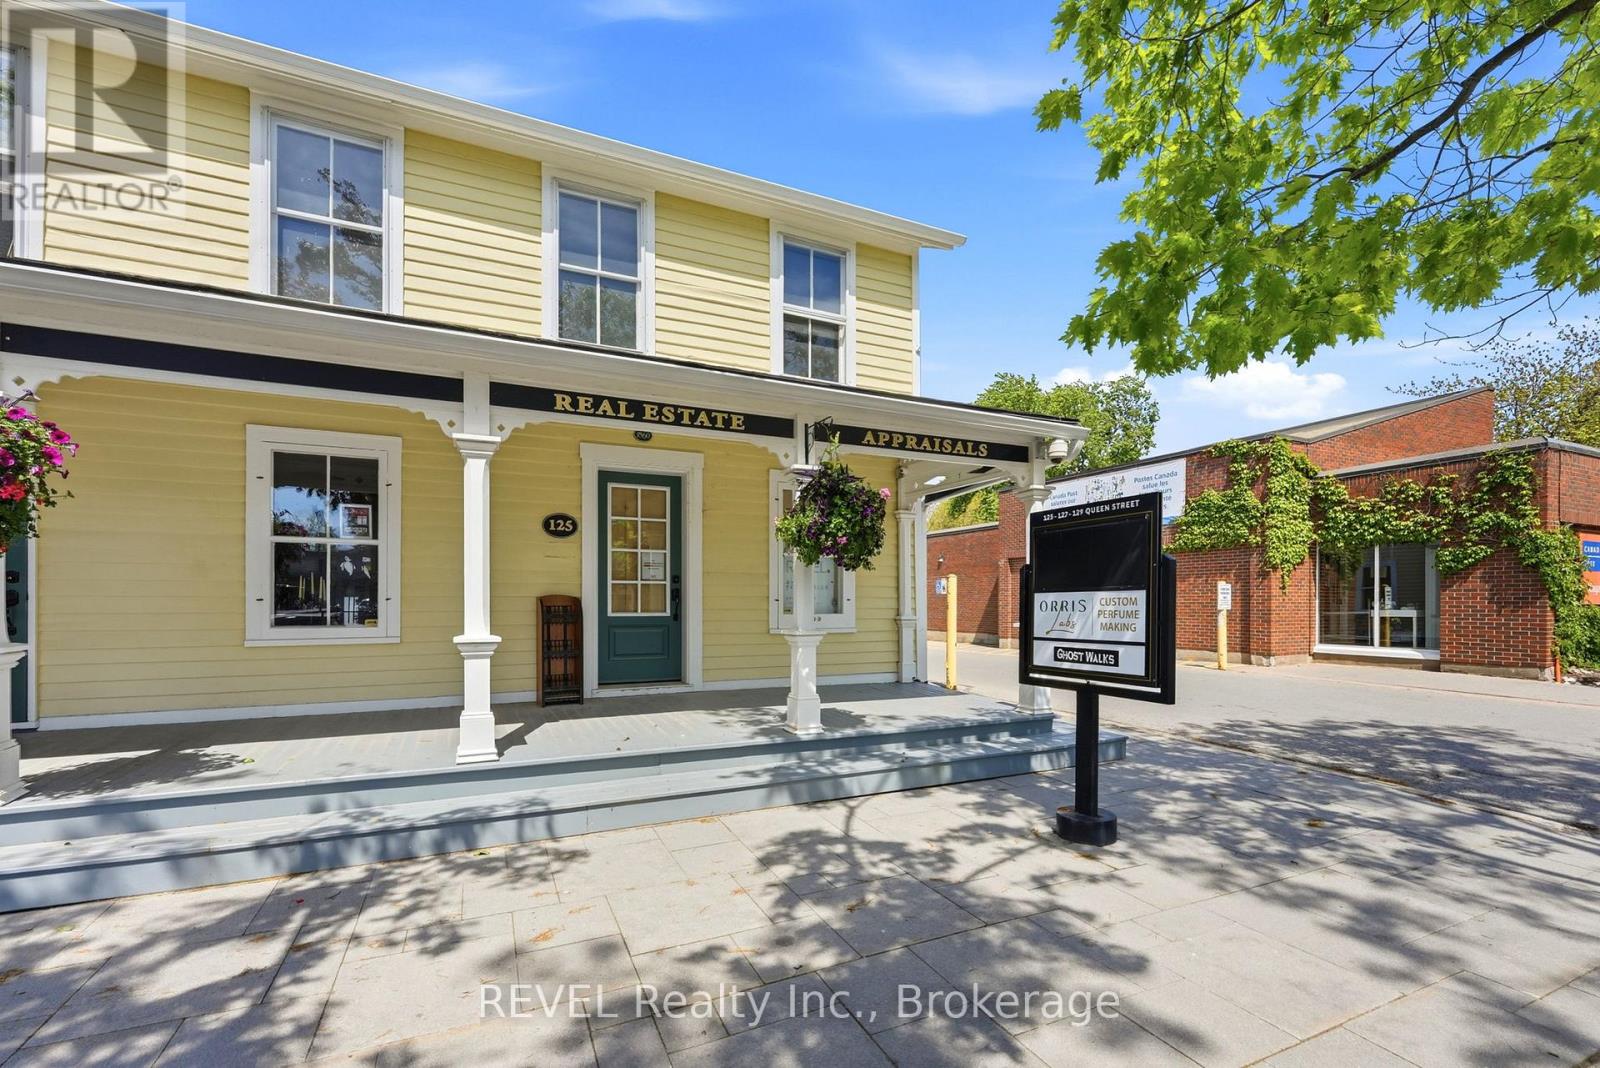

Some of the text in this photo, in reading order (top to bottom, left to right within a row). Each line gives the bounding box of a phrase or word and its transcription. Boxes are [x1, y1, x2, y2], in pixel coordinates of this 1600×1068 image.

[553, 393, 746, 431] REAL ESTATE
[861, 430, 988, 457] APPRAISALS
[1154, 470, 1178, 480] Canada
[1085, 504, 1110, 515] QUEEN
[1111, 499, 1140, 510] STREET
[549, 519, 573, 532] 125
[1039, 599, 1087, 613] ORRIS
[1099, 597, 1137, 606] CUSTOM
[1097, 609, 1140, 619] PERFUME
[1100, 622, 1136, 632] MAKING
